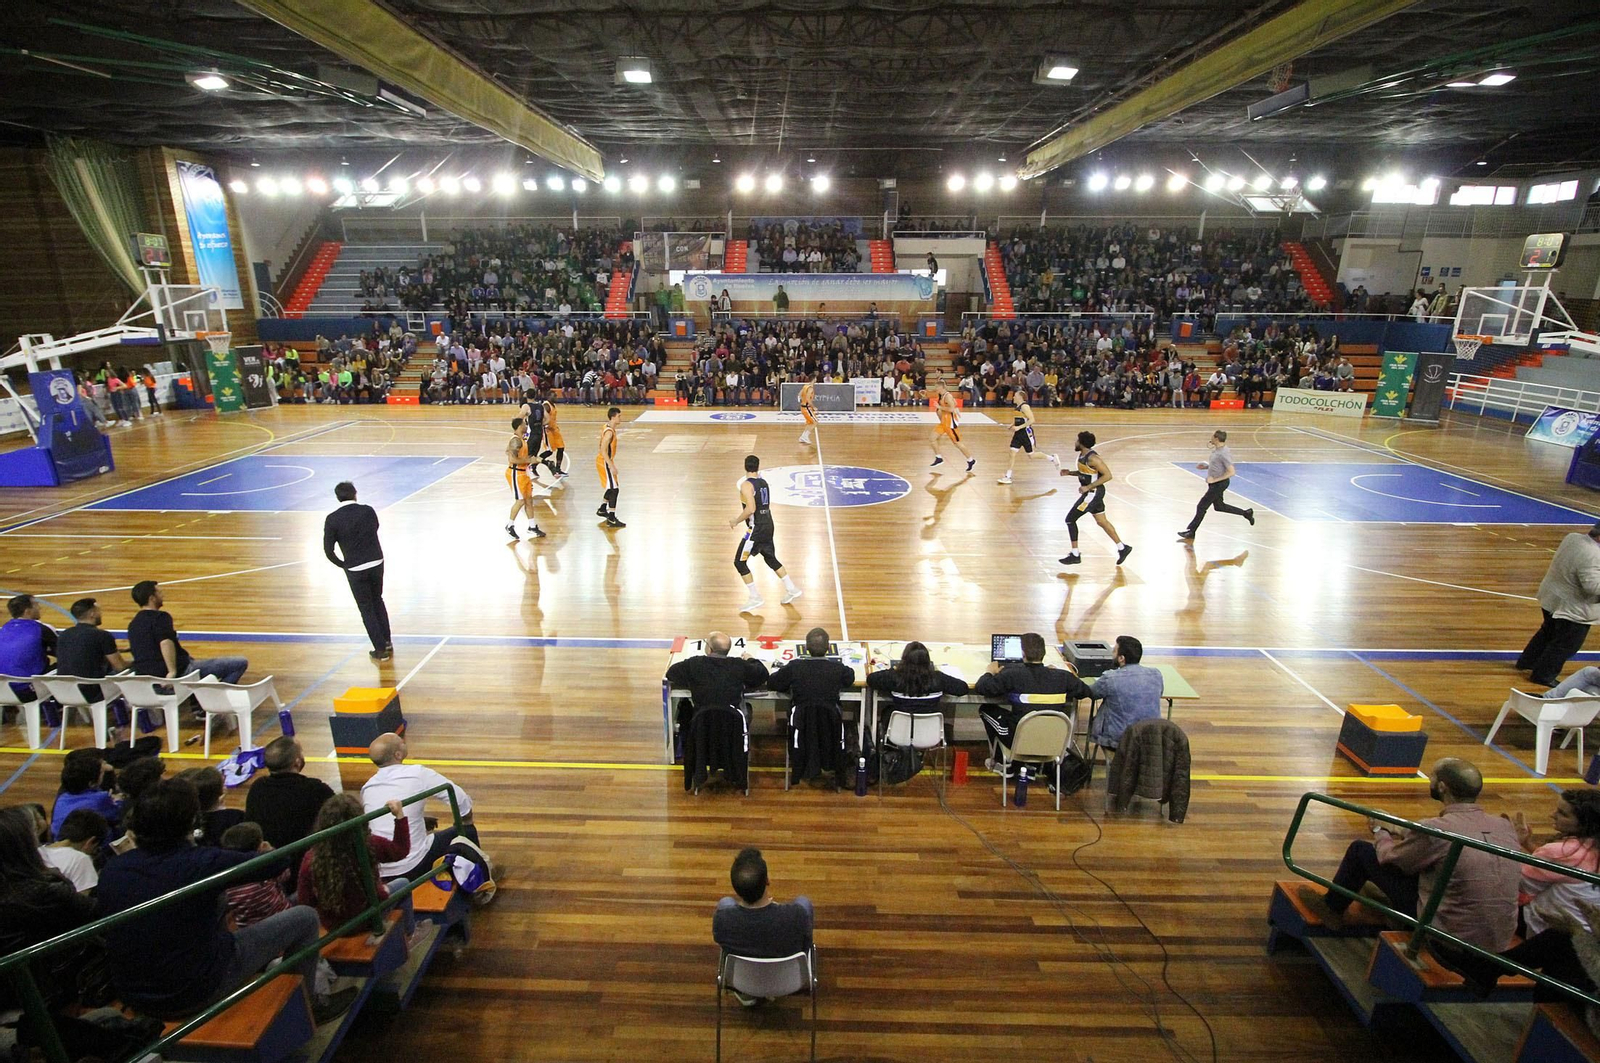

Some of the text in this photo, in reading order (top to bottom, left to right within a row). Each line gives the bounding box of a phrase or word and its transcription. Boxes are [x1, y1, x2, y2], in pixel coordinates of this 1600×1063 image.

[1279, 395, 1363, 410] TODOCOLCHÓN
[734, 637, 746, 648] 4
[781, 649, 794, 661] 5
